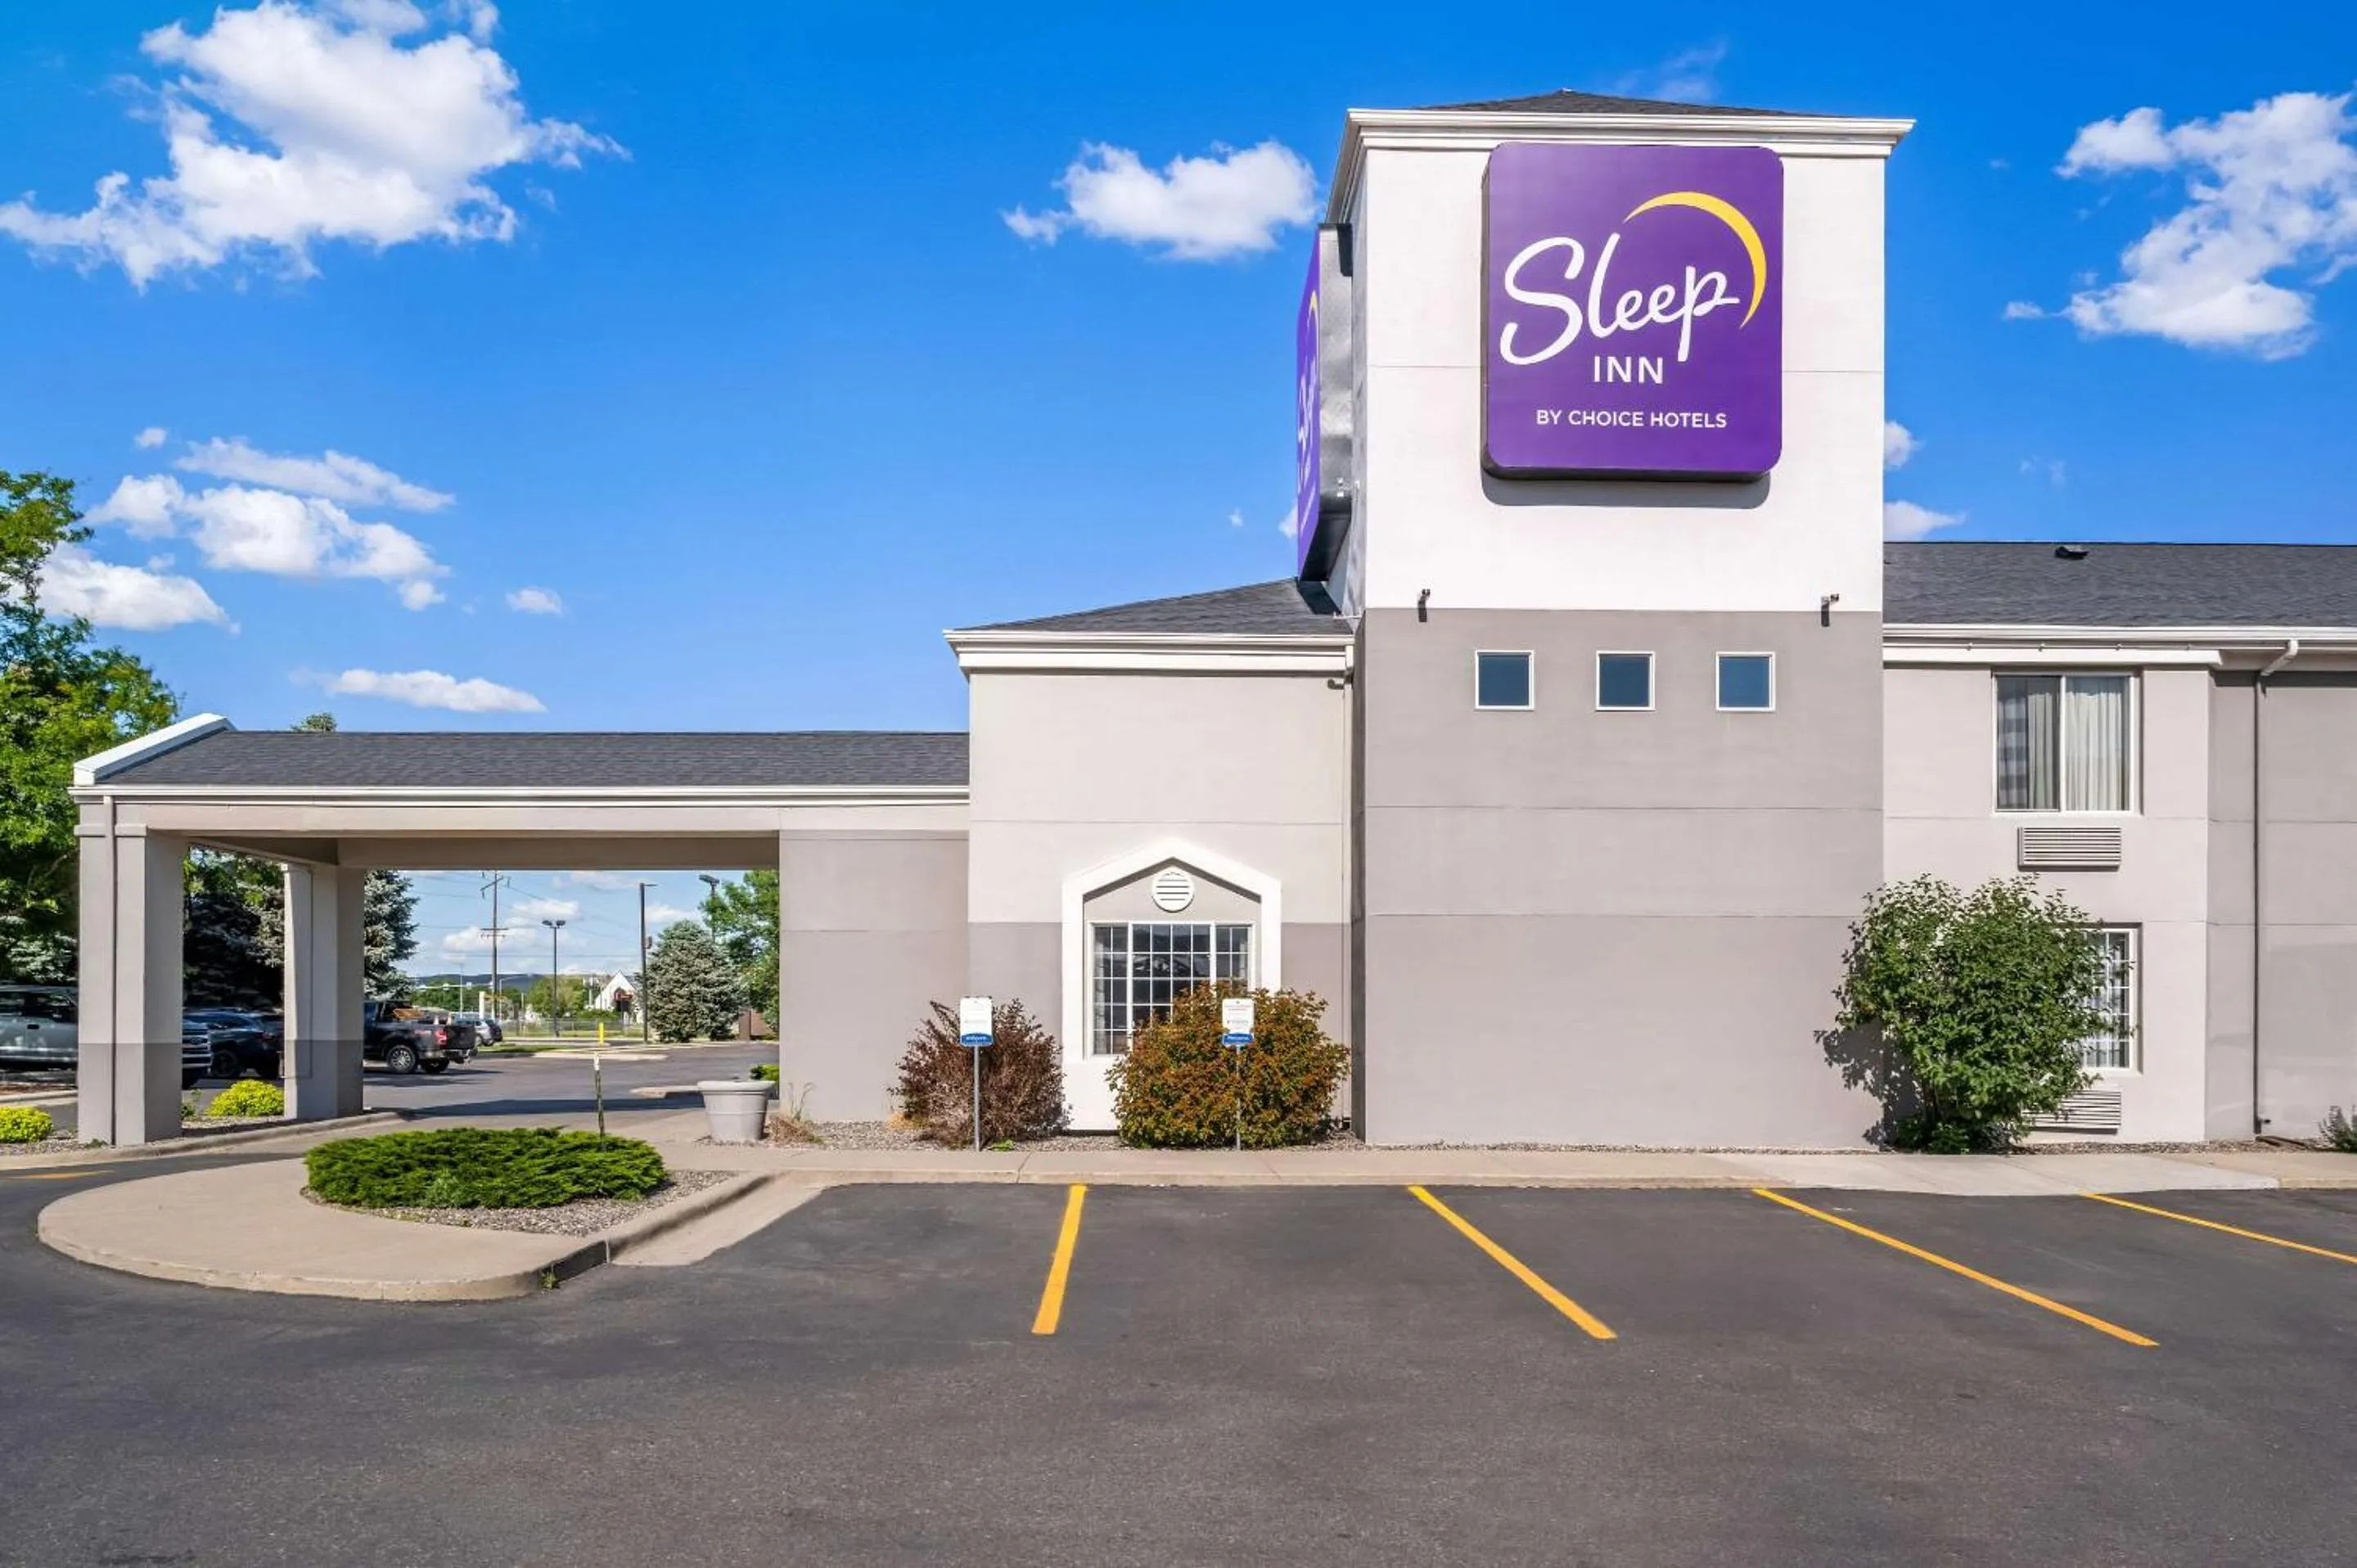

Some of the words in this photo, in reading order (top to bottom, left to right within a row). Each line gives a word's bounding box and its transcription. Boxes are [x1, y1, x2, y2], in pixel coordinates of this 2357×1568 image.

[1499, 232, 1740, 365] Sleep
[1593, 355, 1664, 385] INN
[1536, 409, 1562, 426] BY
[1568, 410, 1644, 427] CHOICE
[1651, 412, 1728, 428] HOTELS
